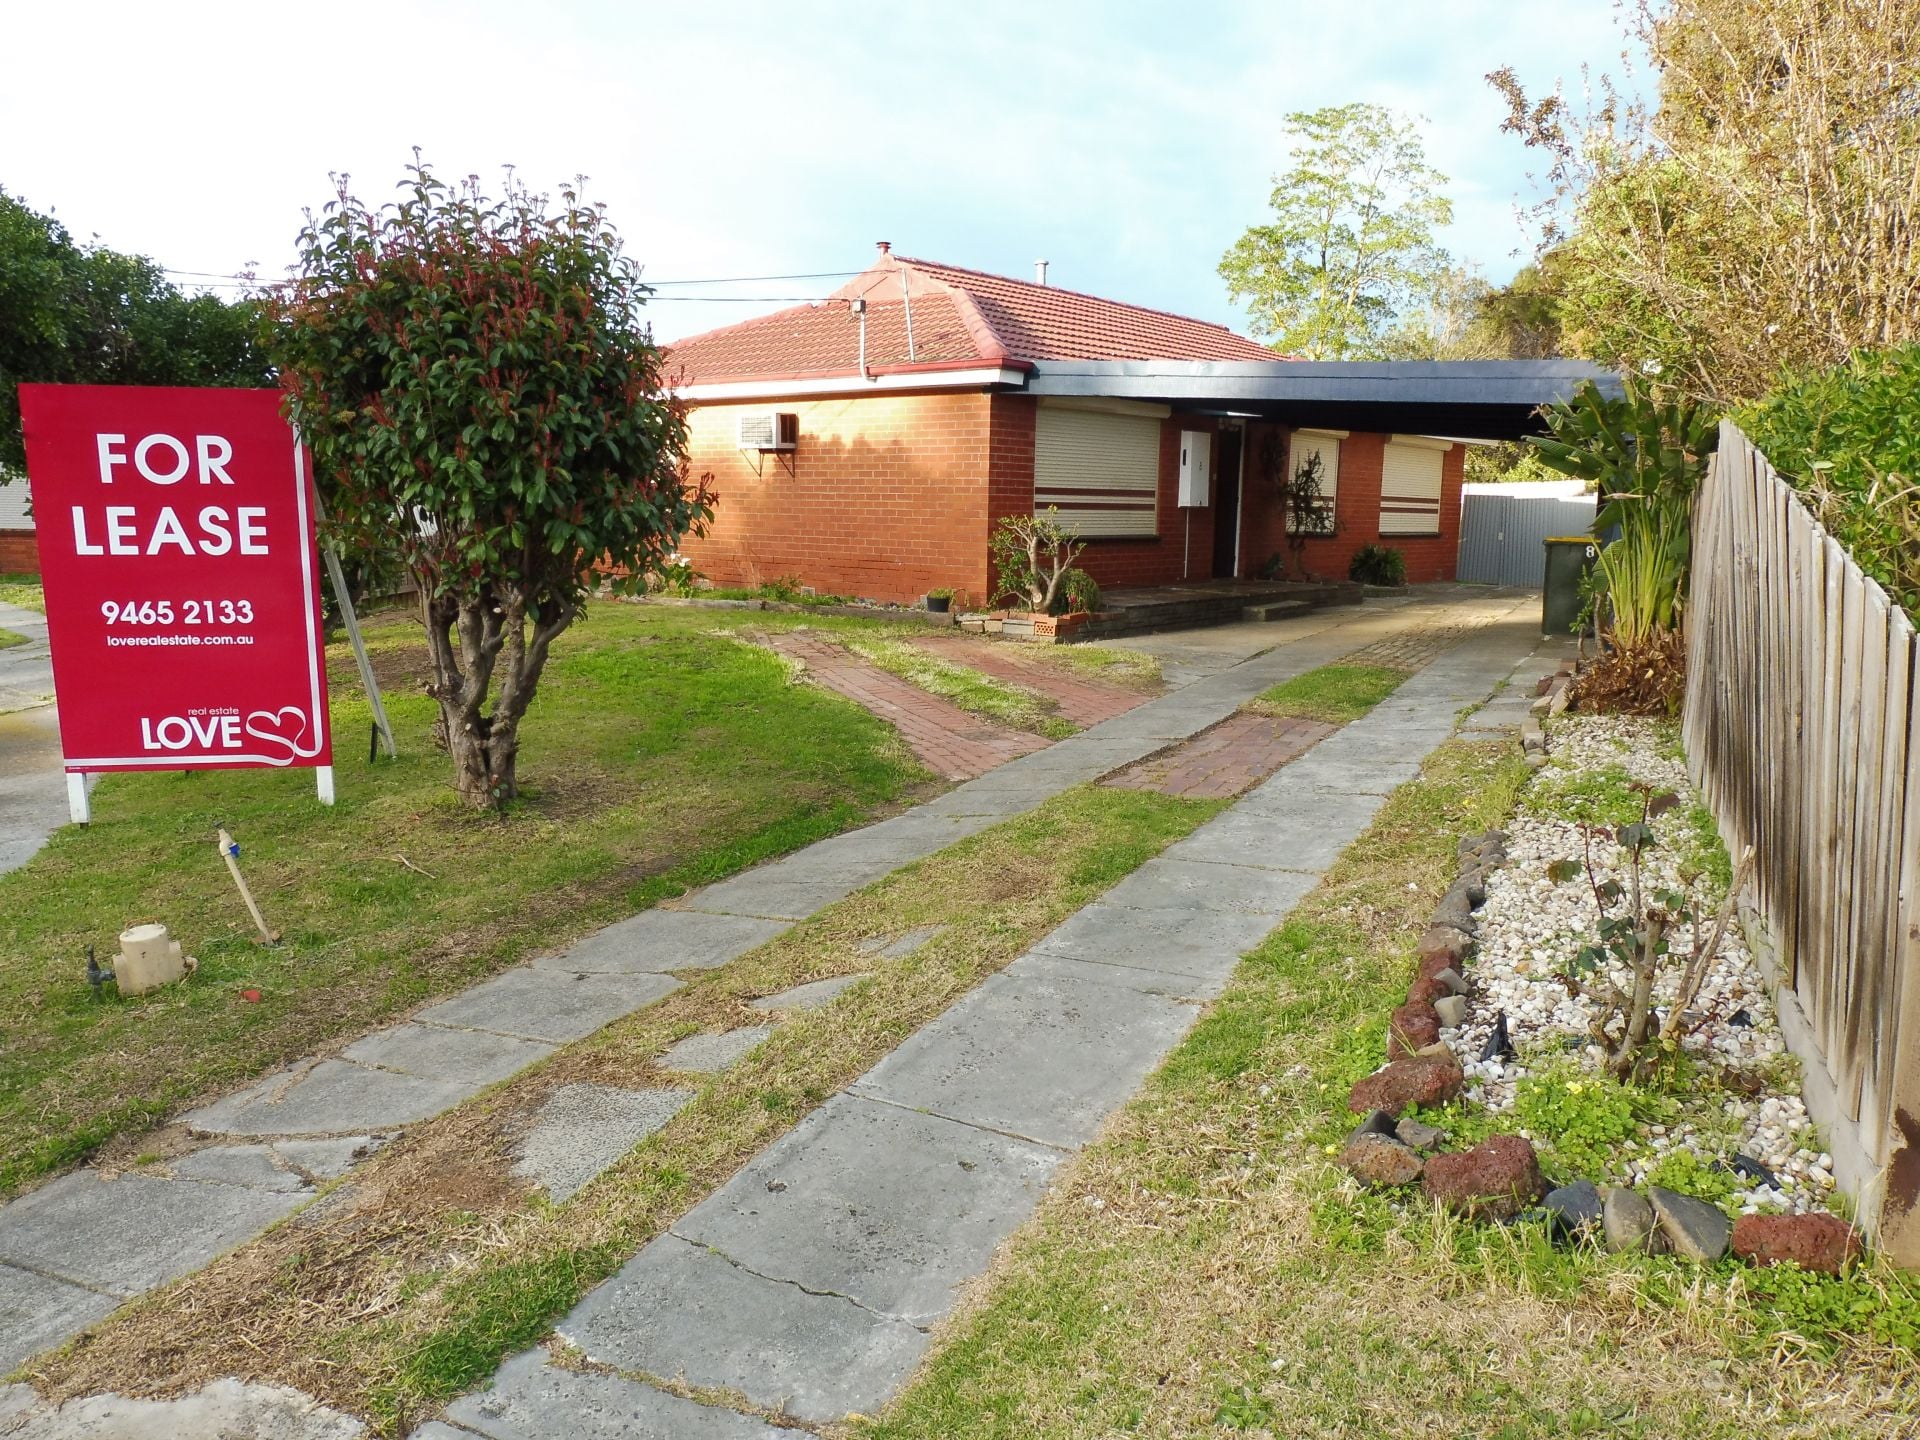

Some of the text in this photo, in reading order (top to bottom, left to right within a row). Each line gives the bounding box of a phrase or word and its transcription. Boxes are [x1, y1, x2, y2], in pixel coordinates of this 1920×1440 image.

[96, 433, 235, 485] FOR
[71, 505, 269, 556] LEASE
[1586, 545, 1595, 558] 8
[101, 599, 254, 625] 9465 2133
[106, 635, 254, 647] loverealestate.com.au
[187, 706, 240, 716] real estate
[140, 715, 243, 750] LOVE
